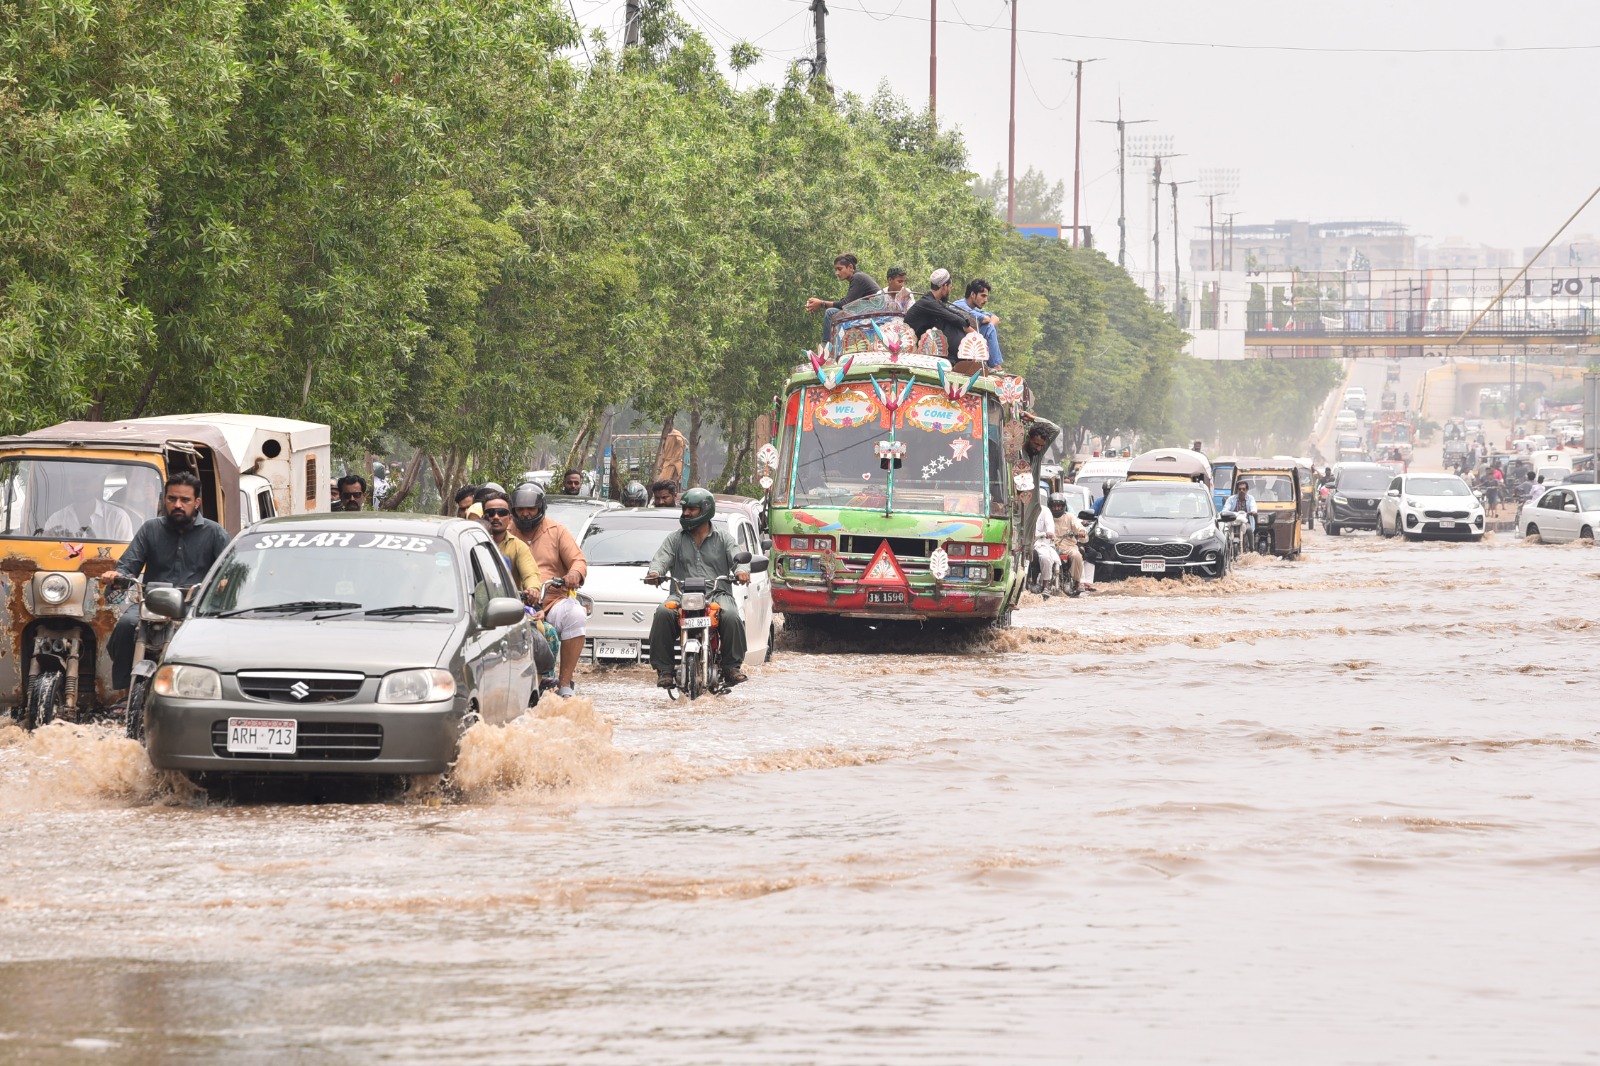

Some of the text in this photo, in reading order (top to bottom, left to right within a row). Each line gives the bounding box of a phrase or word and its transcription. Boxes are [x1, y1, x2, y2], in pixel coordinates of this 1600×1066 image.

[835, 405, 855, 414] WEL
[923, 409, 953, 420] COME
[255, 532, 433, 553] SHAH JEE
